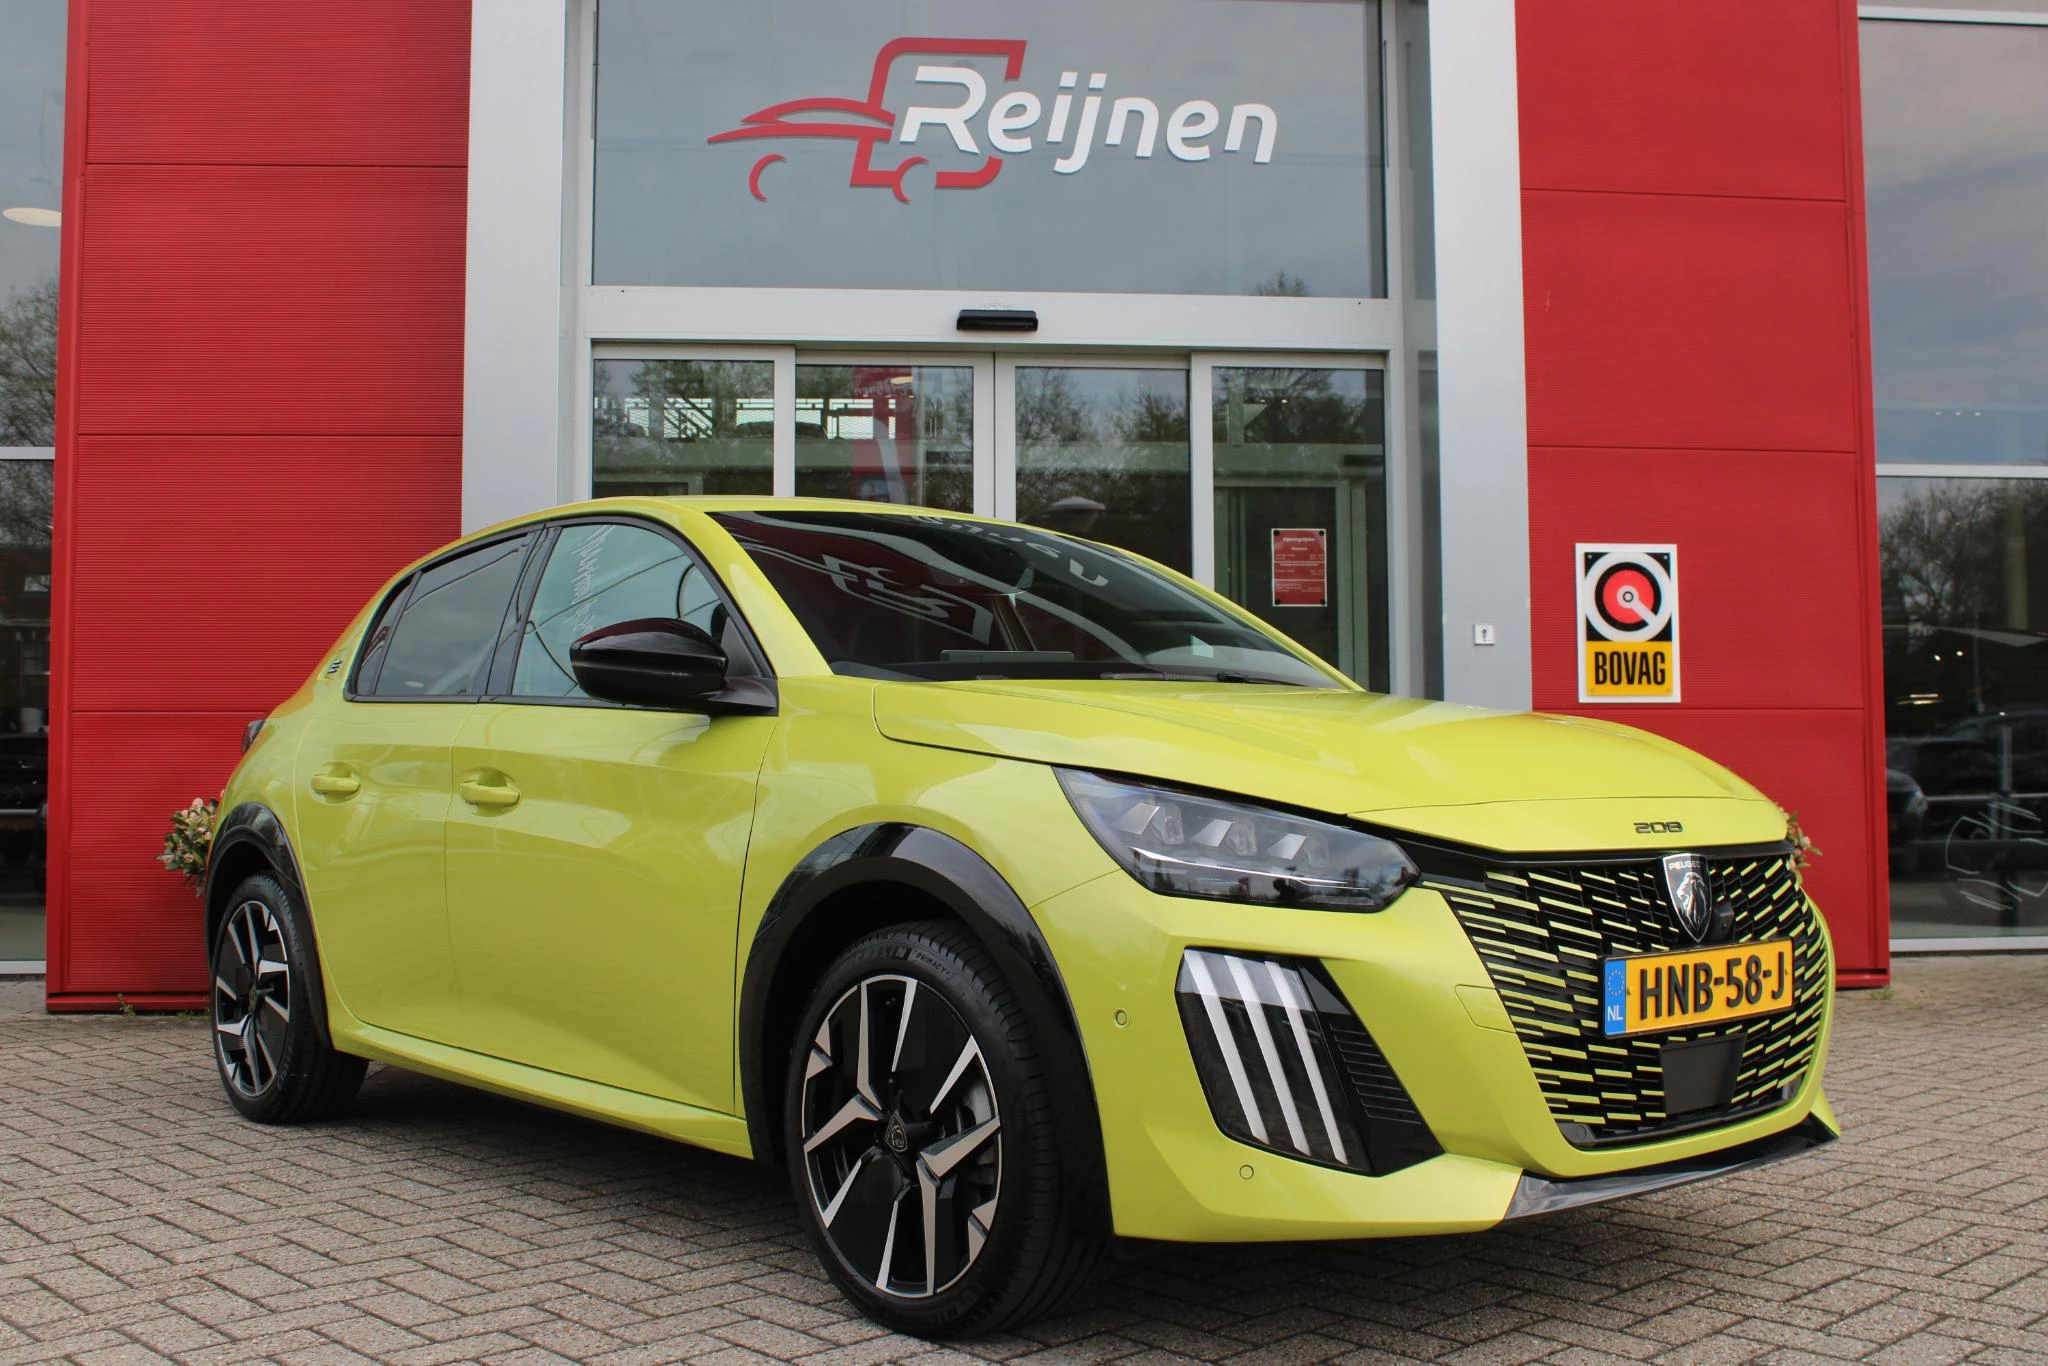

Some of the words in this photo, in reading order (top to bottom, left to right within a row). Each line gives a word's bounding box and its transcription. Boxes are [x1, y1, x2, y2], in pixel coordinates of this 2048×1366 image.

[900, 65, 1278, 174] Reijnen
[1594, 651, 1666, 686] BOVAG
[1633, 821, 1684, 834] 208
[1640, 951, 1785, 1021] HNB-58-J
[1607, 1005, 1624, 1022] NL
